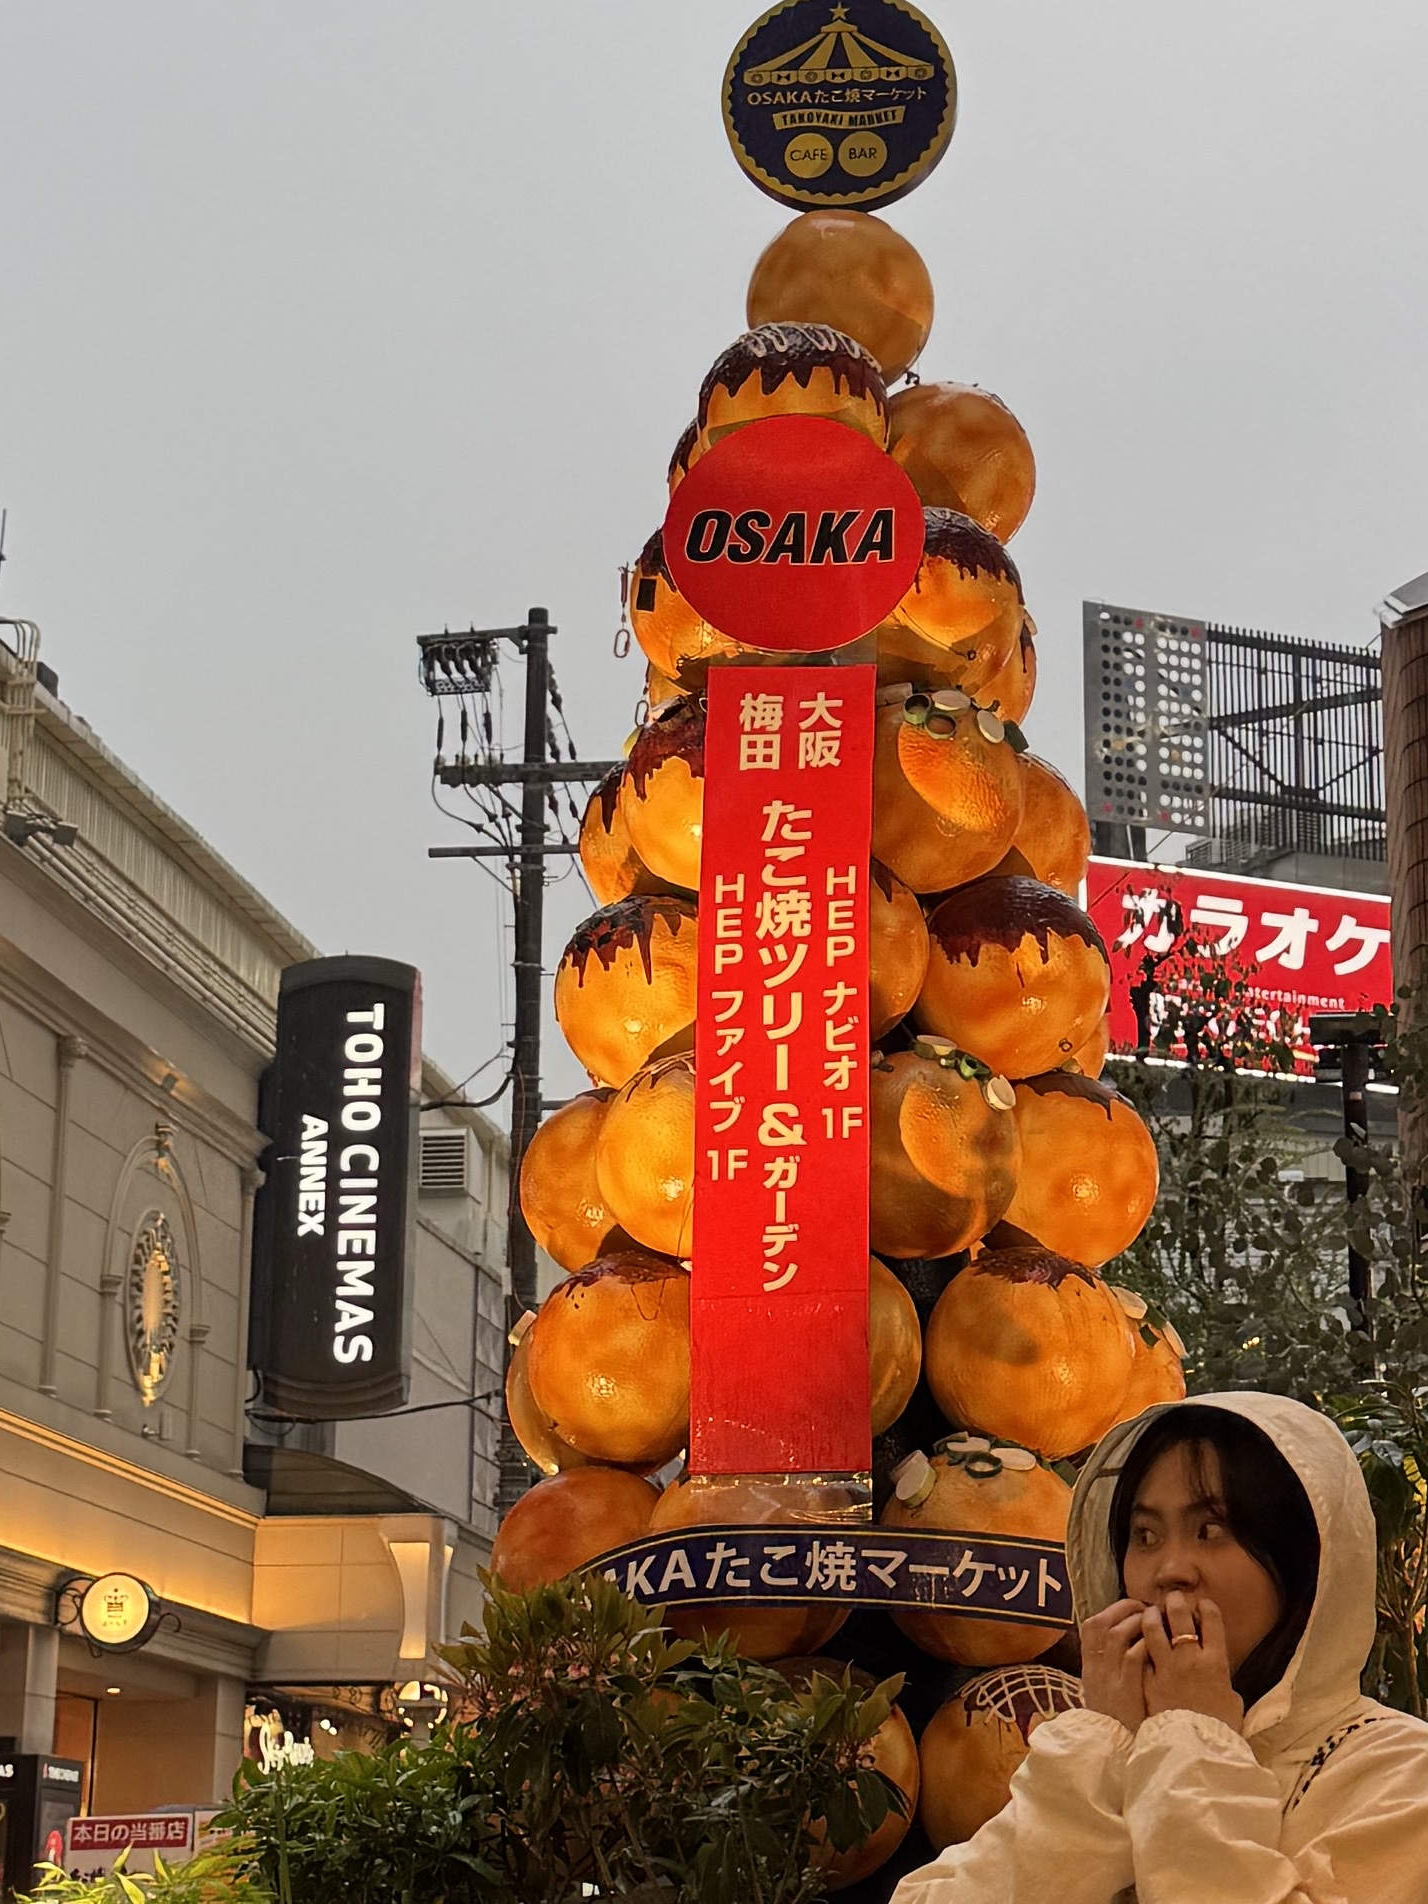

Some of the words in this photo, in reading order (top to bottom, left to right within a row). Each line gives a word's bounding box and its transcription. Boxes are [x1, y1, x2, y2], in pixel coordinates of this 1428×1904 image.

[781, 112, 843, 127] TAKOYAKI
[848, 110, 897, 127] MARKET
[790, 149, 828, 162] CAFE
[848, 147, 877, 160] BAR
[684, 507, 896, 565] OSAKA
[738, 692, 784, 771] 梅田
[798, 692, 844, 769] 大阪
[1116, 887, 1392, 977] カラオケ
[1240, 986, 1345, 1010] ntertainment
[823, 981, 860, 1091] ナビオ
[340, 1002, 385, 1132] TOHO
[822, 1106, 864, 1139] 1F
[297, 1114, 329, 1238] ANNEX
[707, 1149, 749, 1181] 1F
[332, 1143, 381, 1365] CINEMAS
[73, 1820, 186, 1843] 本日の当番店
